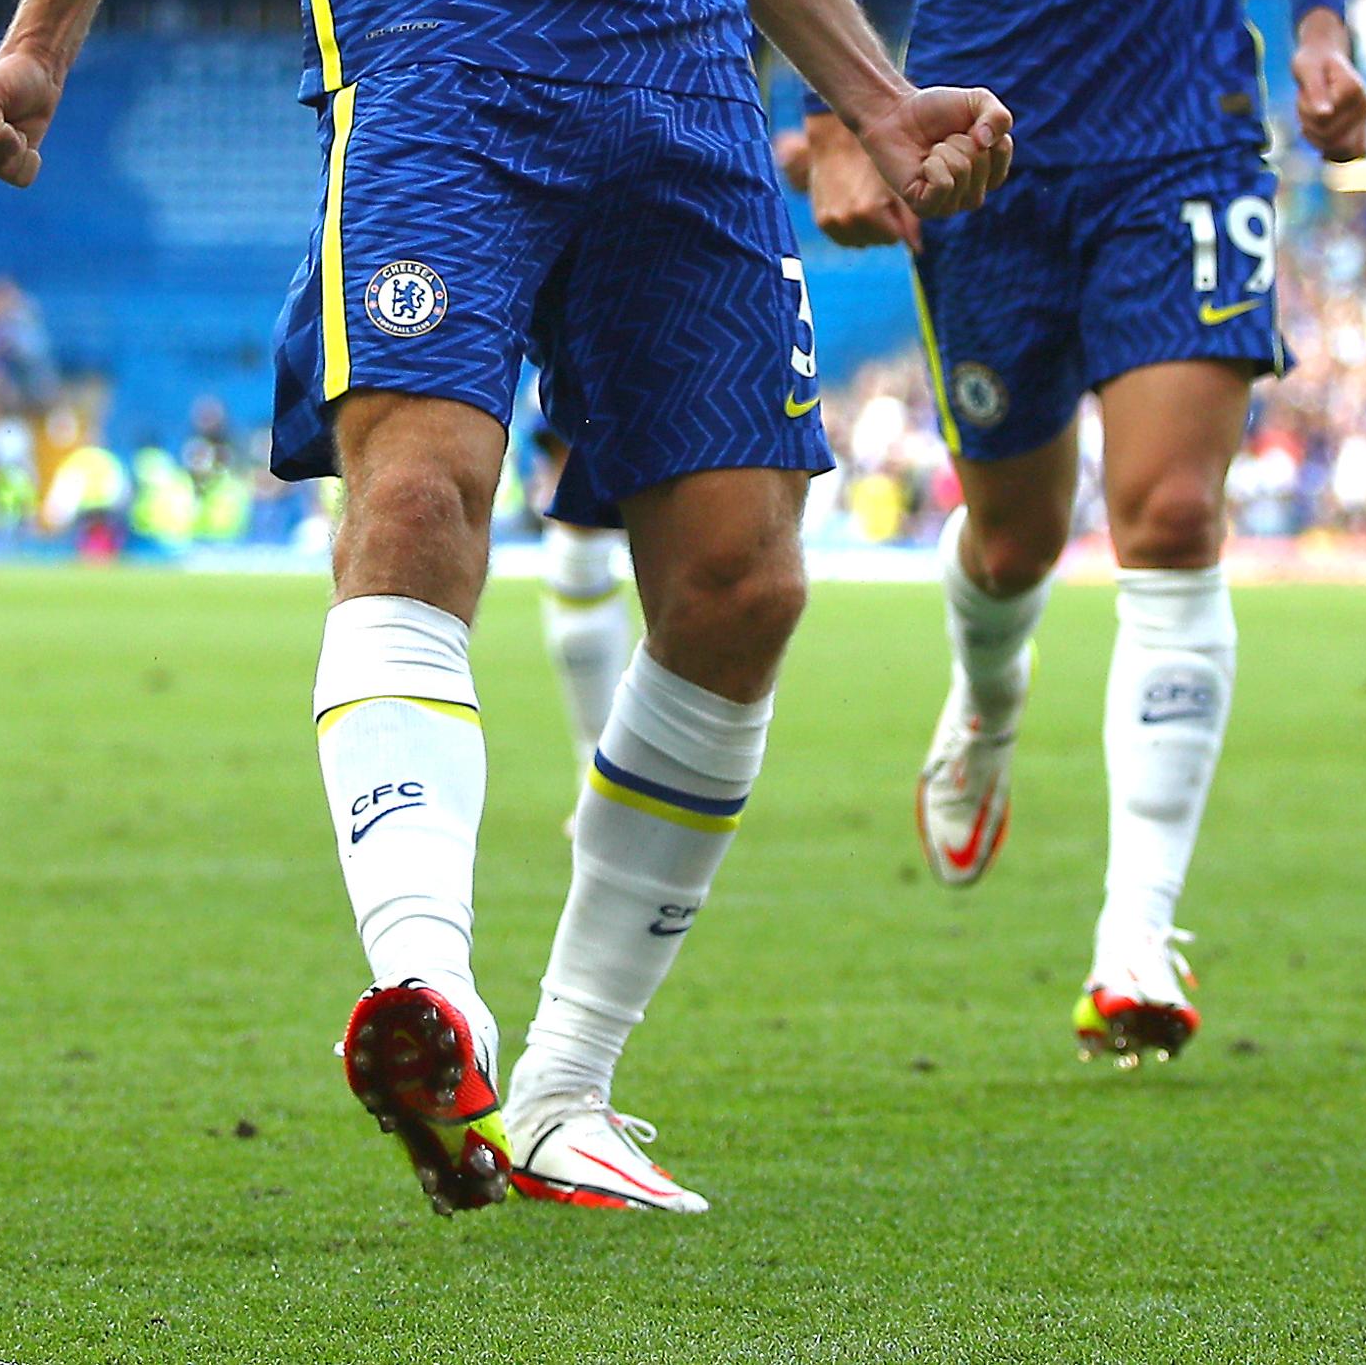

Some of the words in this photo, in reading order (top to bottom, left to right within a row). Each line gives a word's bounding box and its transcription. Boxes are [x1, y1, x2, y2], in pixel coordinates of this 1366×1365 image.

[1181, 195, 1276, 293] 19
[382, 263, 435, 284] CHELSEA
[351, 781, 424, 816] CFC
